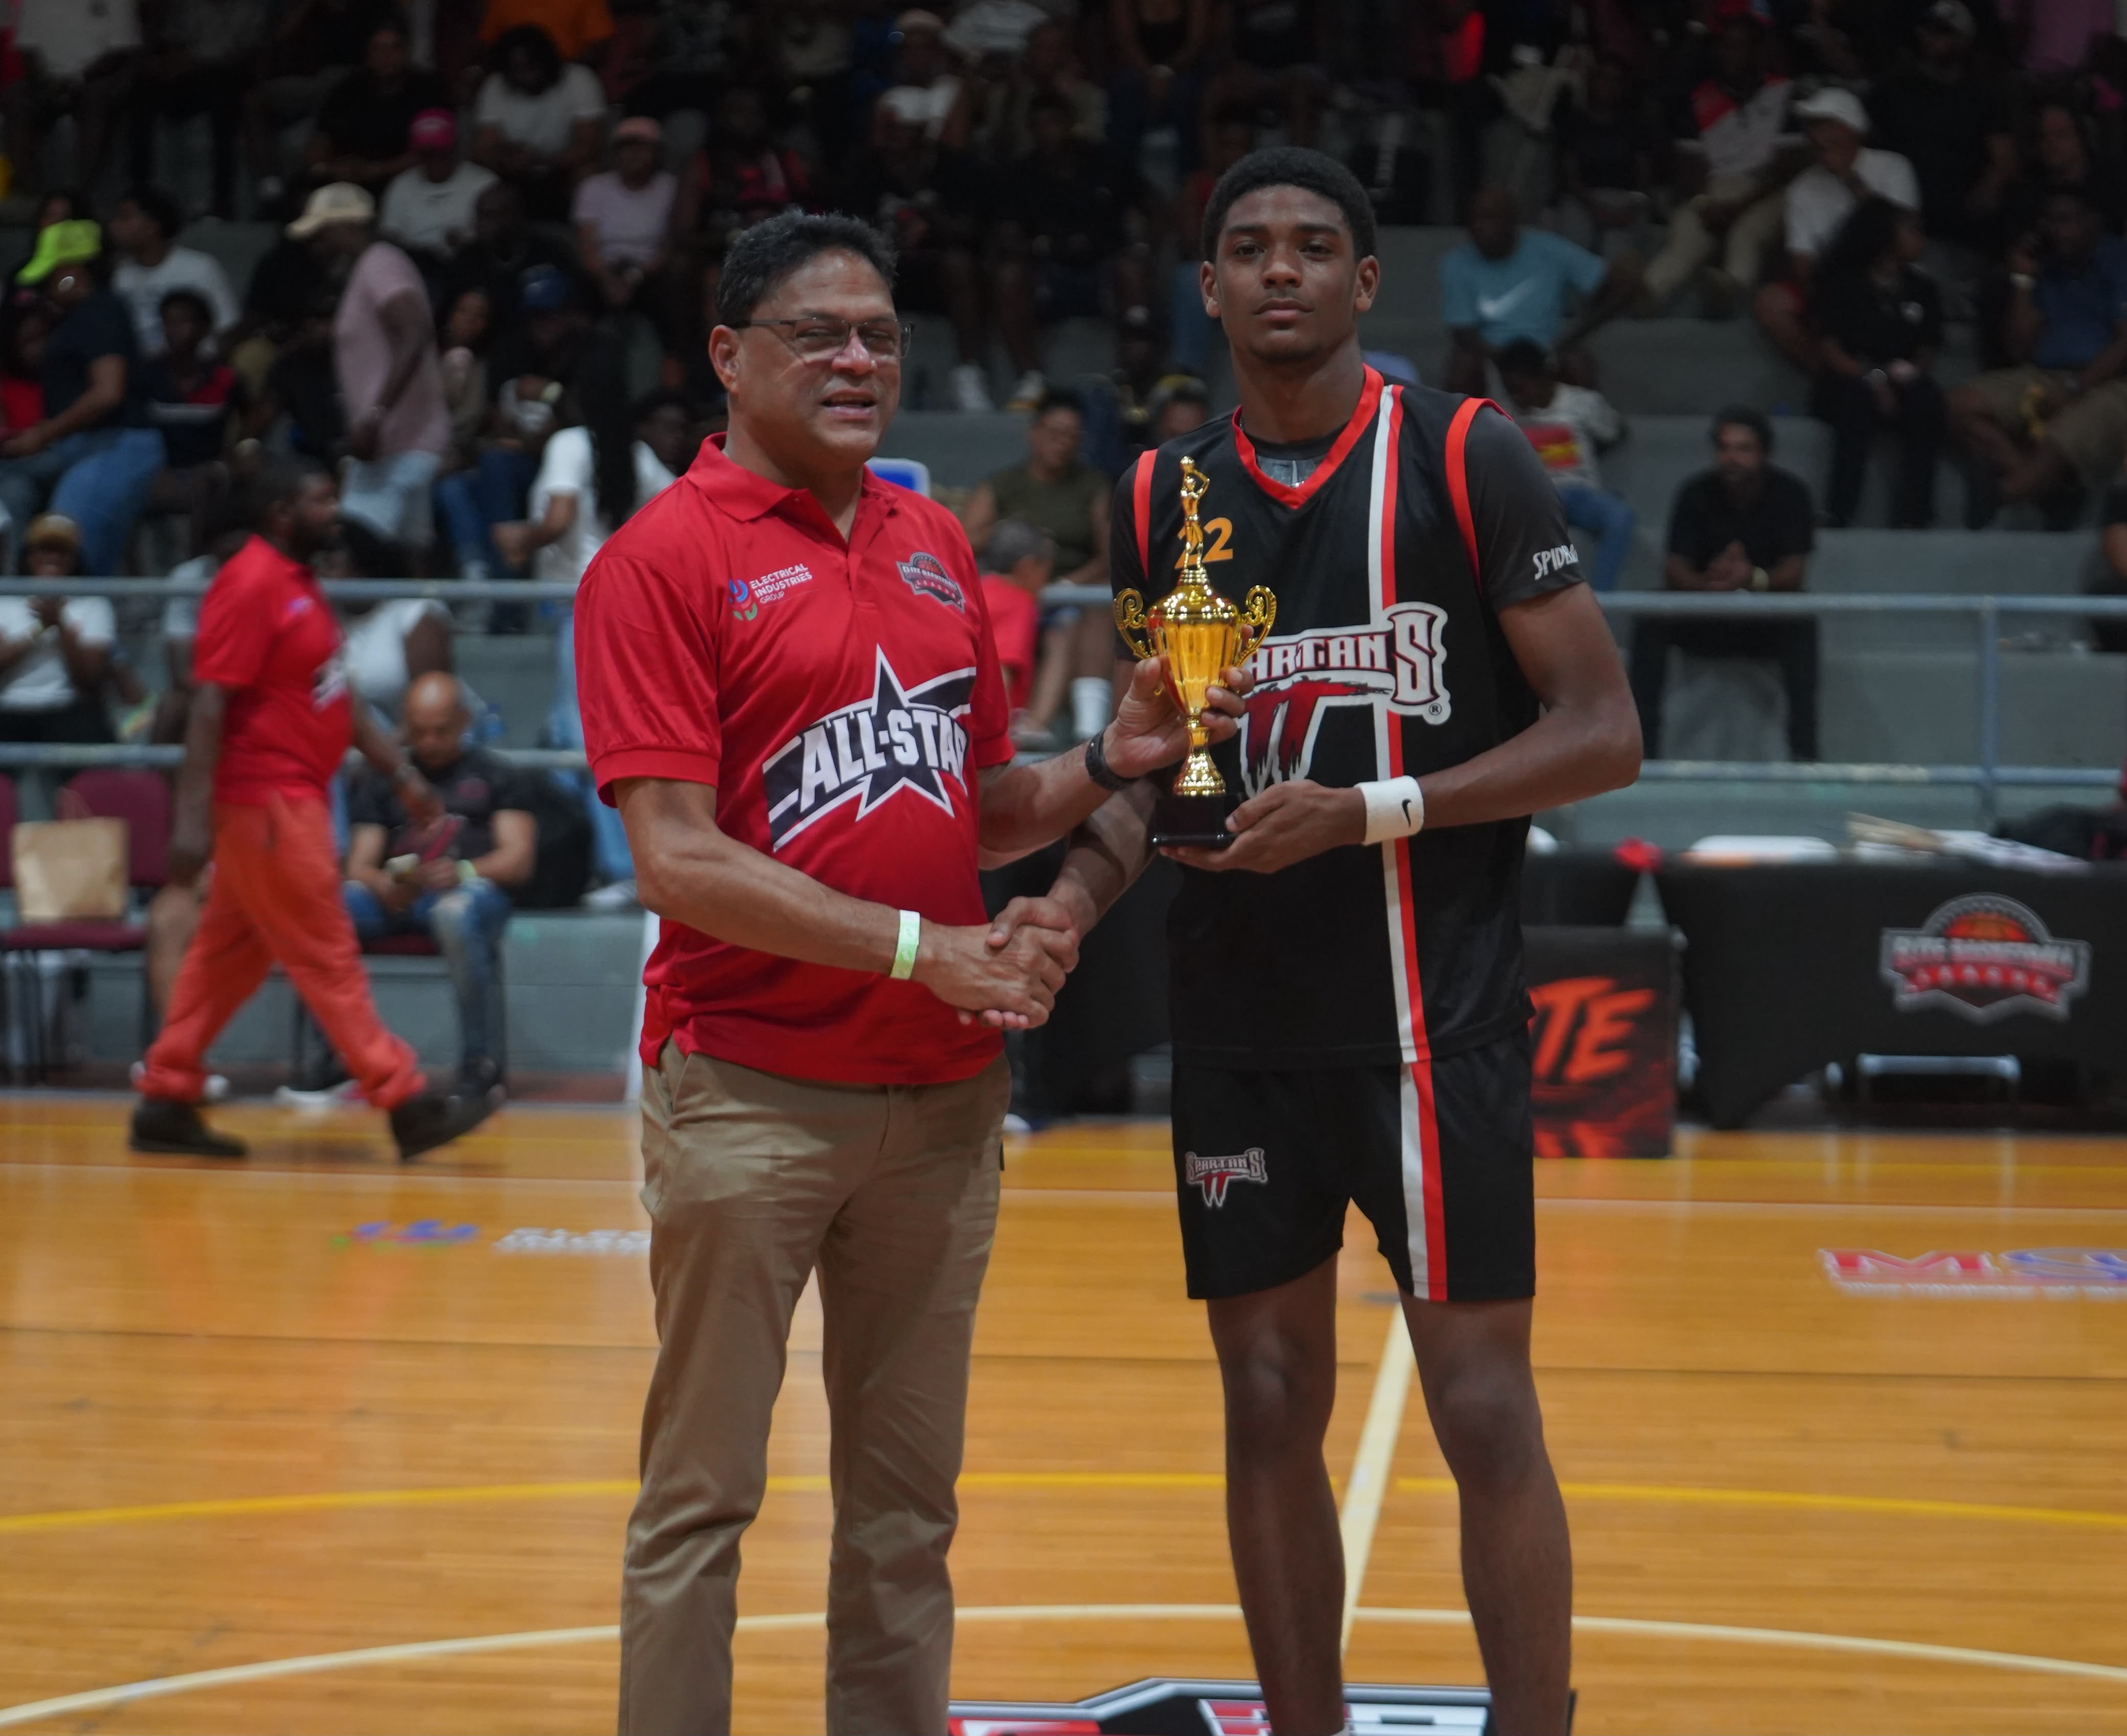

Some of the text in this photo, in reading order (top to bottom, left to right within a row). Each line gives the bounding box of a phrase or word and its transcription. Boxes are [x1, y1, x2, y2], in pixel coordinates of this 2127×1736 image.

[1174, 517, 1233, 569] 22
[749, 563, 808, 589] ELECTRICAL
[754, 571, 812, 598] INDUSTRIES
[759, 591, 785, 604] GROUP
[1248, 608, 1440, 705] ARTANS
[1527, 976, 1656, 1081] TE
[1185, 1149, 1262, 1181] SPARTANS
